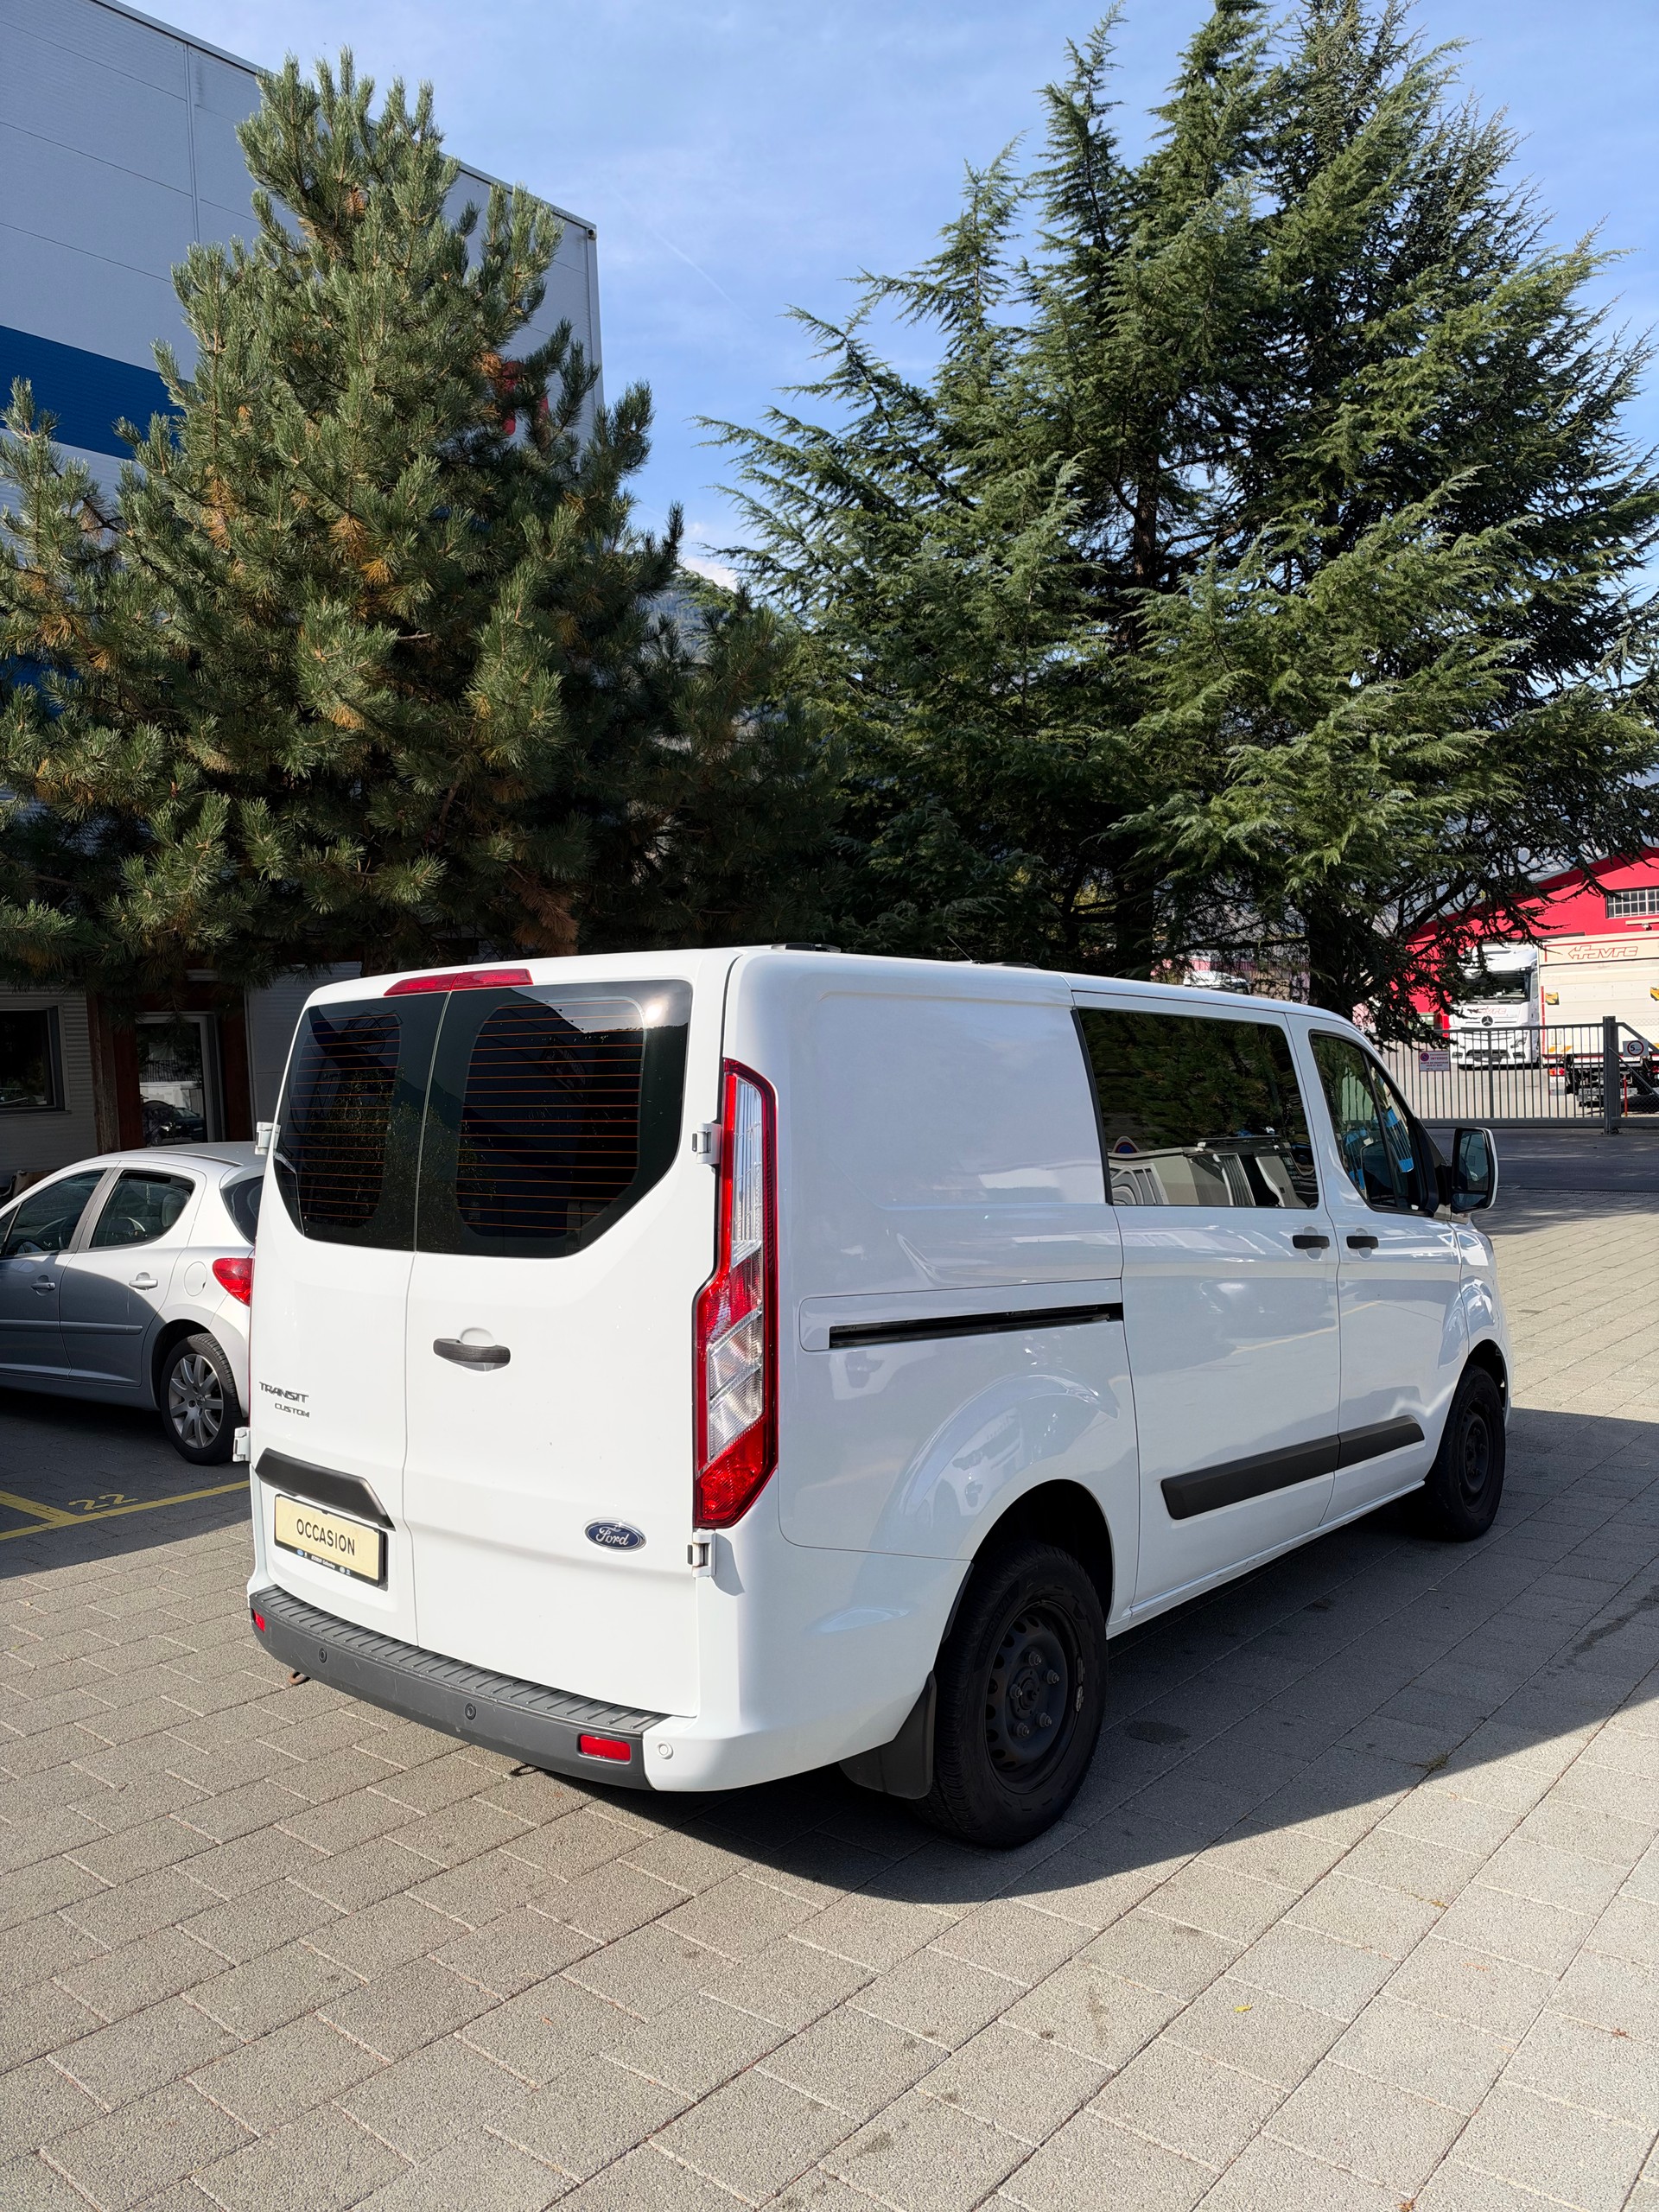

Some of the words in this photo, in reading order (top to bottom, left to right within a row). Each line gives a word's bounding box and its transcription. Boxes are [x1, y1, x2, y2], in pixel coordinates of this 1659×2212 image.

[258, 1381, 309, 1403] TRANSIT
[274, 1402, 310, 1418] CUSTOM
[68, 1493, 139, 1510] 22
[296, 1518, 355, 1556] OCCASION
[595, 1526, 631, 1546] Ford
